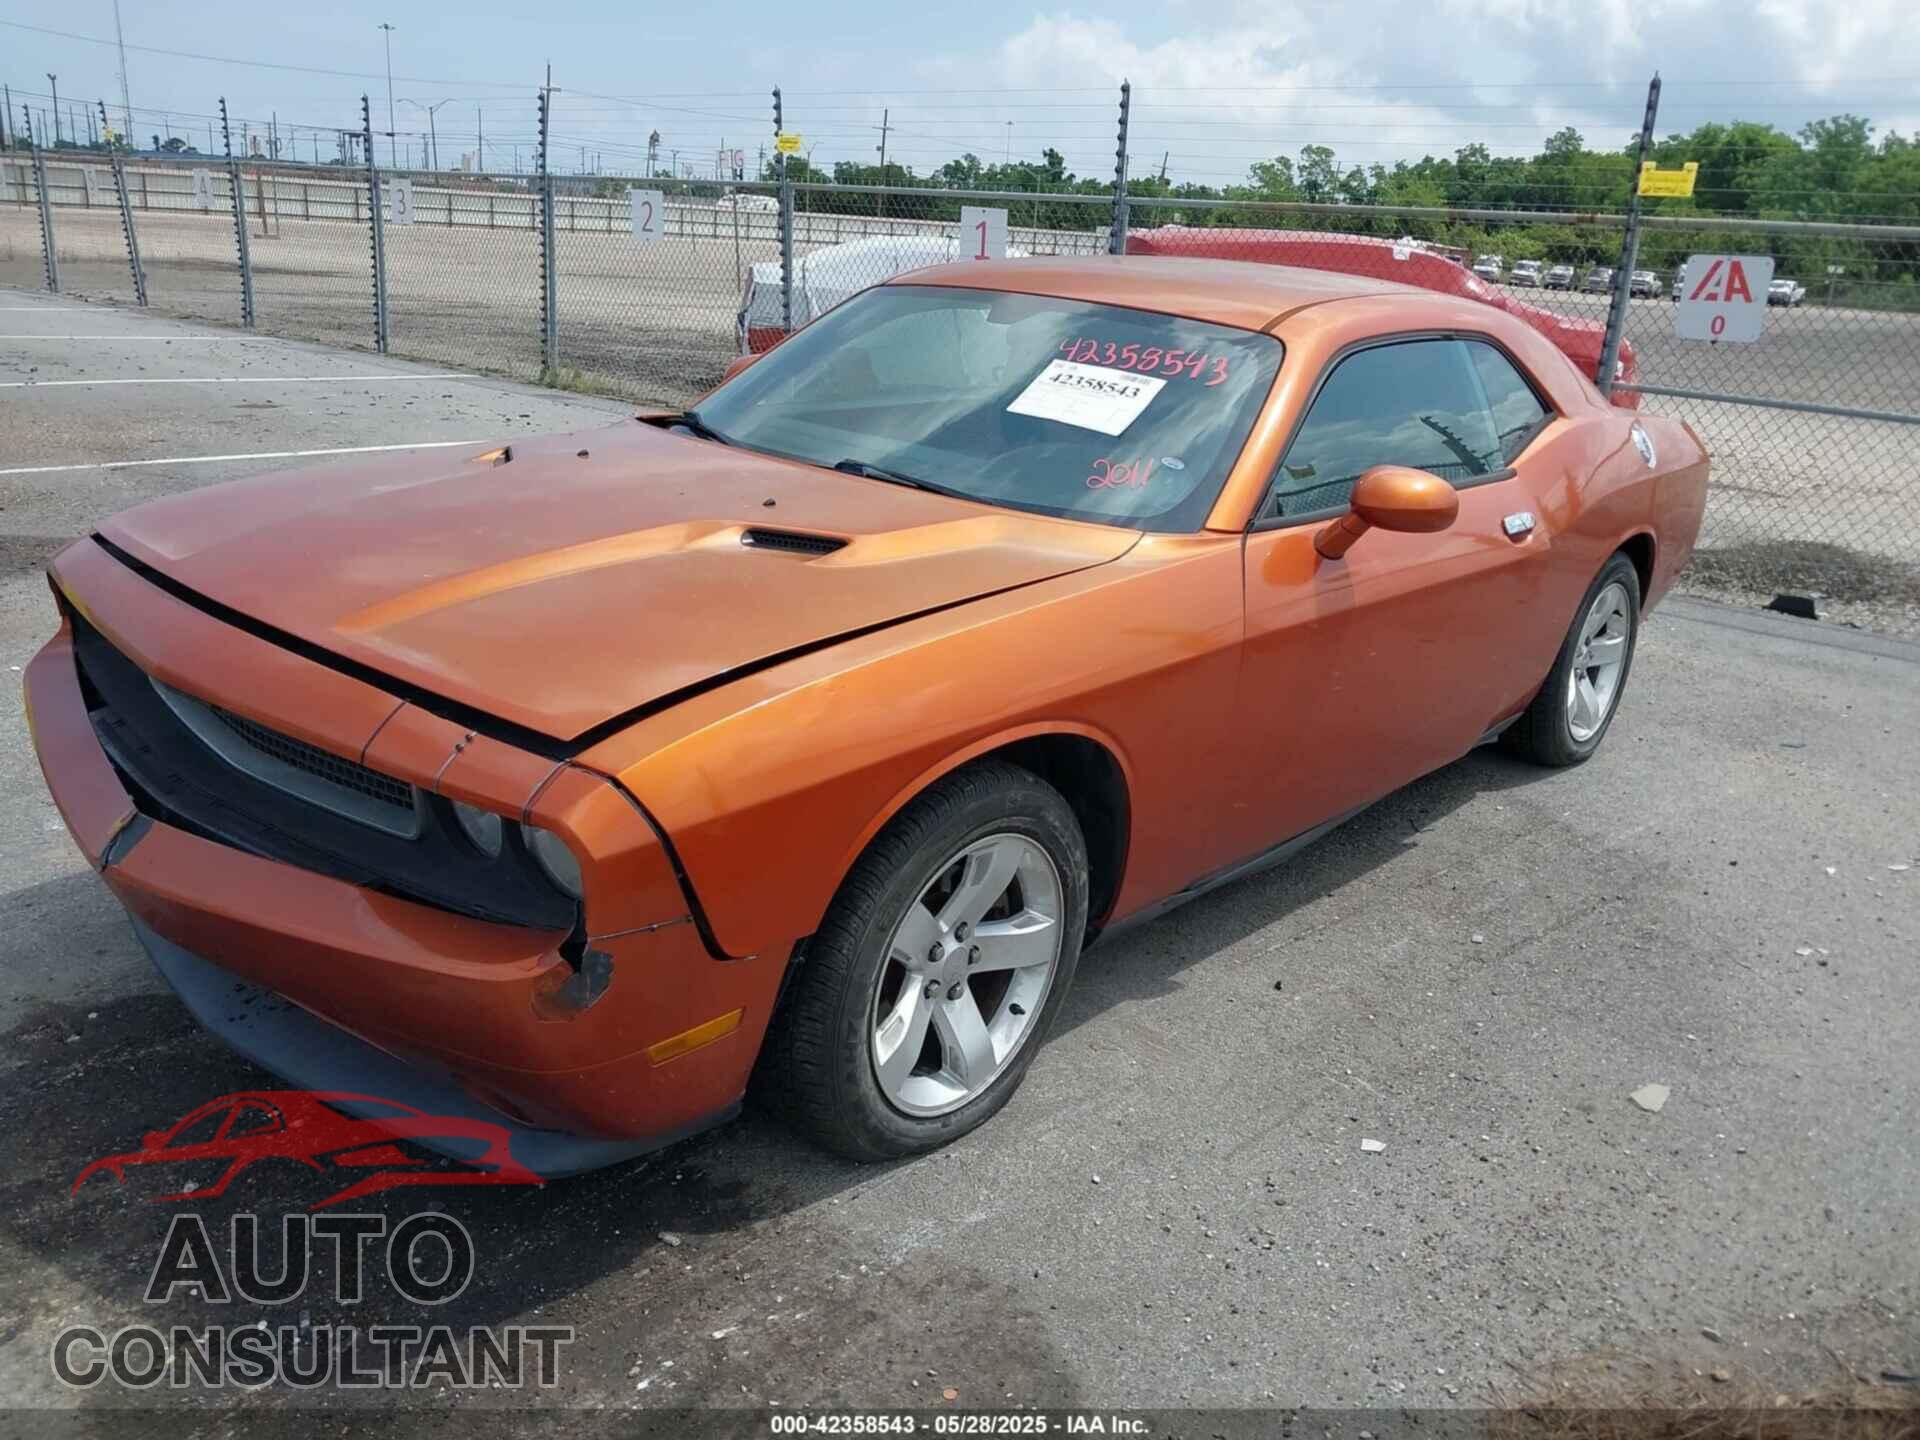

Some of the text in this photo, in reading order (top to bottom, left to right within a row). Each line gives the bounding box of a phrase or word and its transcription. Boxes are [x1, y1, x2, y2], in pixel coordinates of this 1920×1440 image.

[397, 188, 406, 215] 3
[640, 200, 654, 233] 2
[975, 220, 991, 260] 1
[1059, 337, 1229, 387] 42358543
[1048, 373, 1141, 398] 42358543
[1086, 457, 1155, 489] 2011
